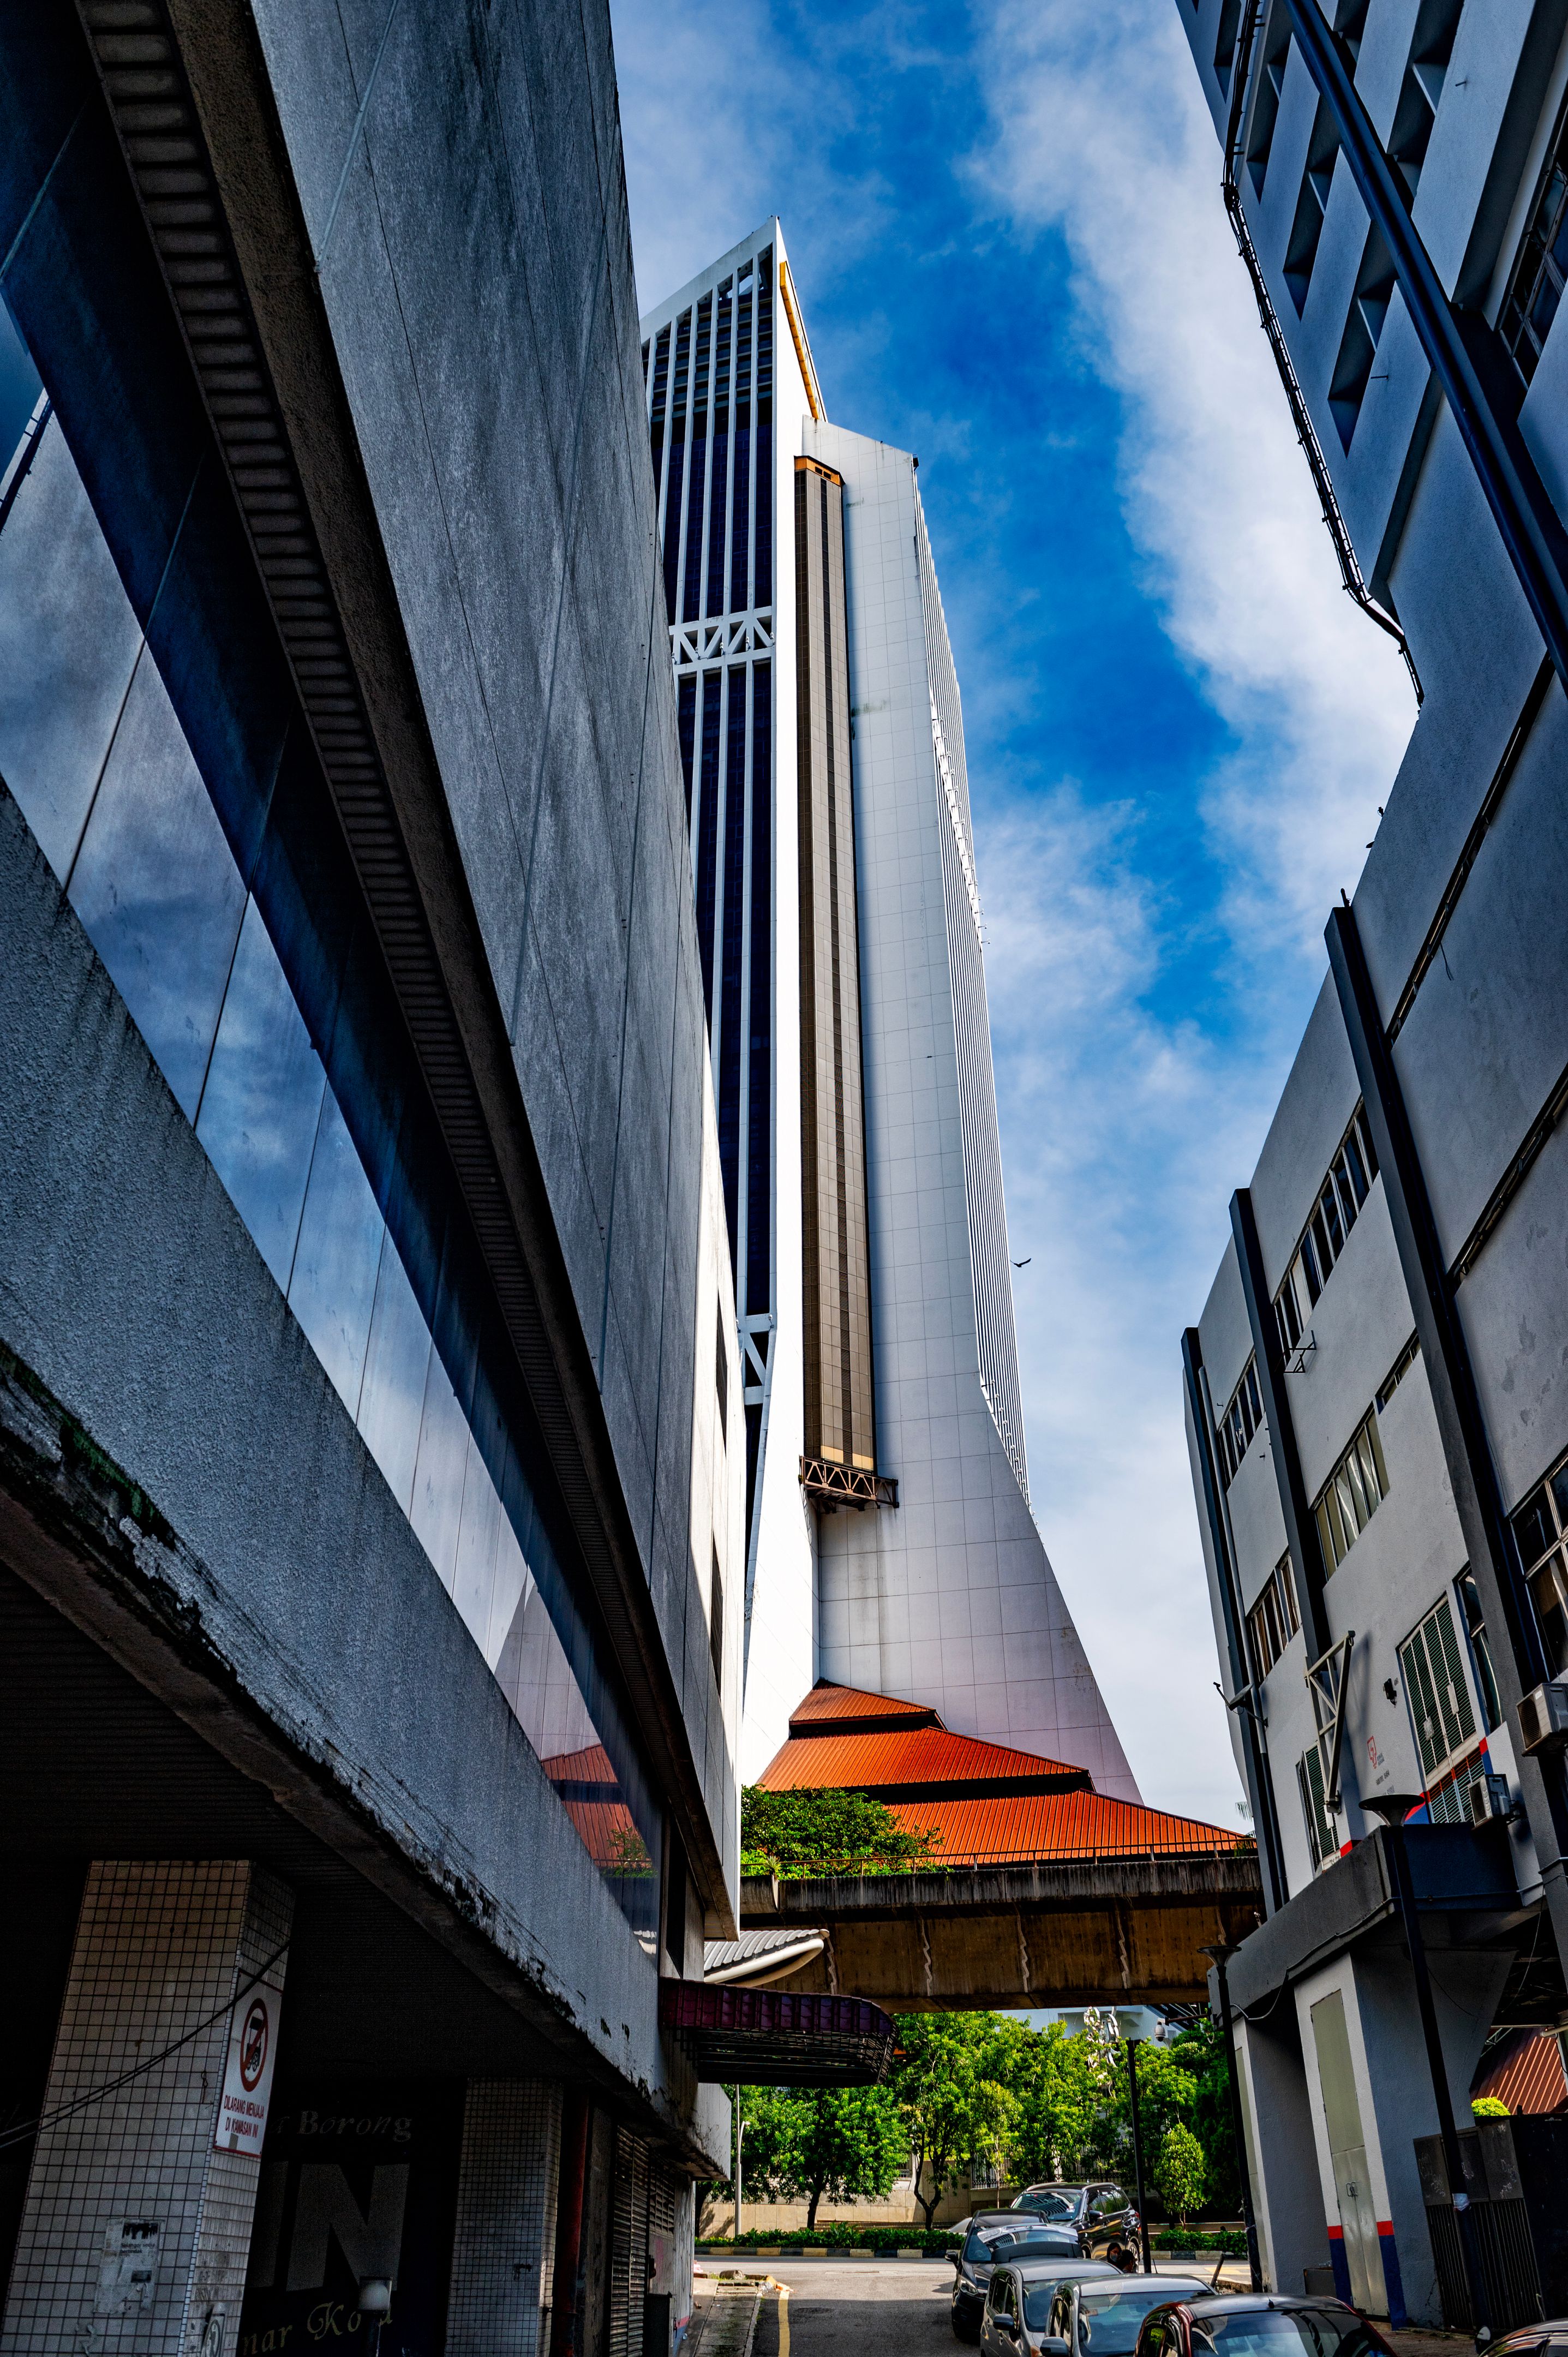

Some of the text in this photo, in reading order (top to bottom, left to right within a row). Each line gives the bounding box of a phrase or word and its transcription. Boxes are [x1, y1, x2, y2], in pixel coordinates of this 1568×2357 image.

[224, 2095, 265, 2119] DILARANG MENJAJA
[225, 2117, 231, 2131] DI
[231, 2118, 252, 2136] KAWASAN
[297, 2108, 413, 2142] Borong
